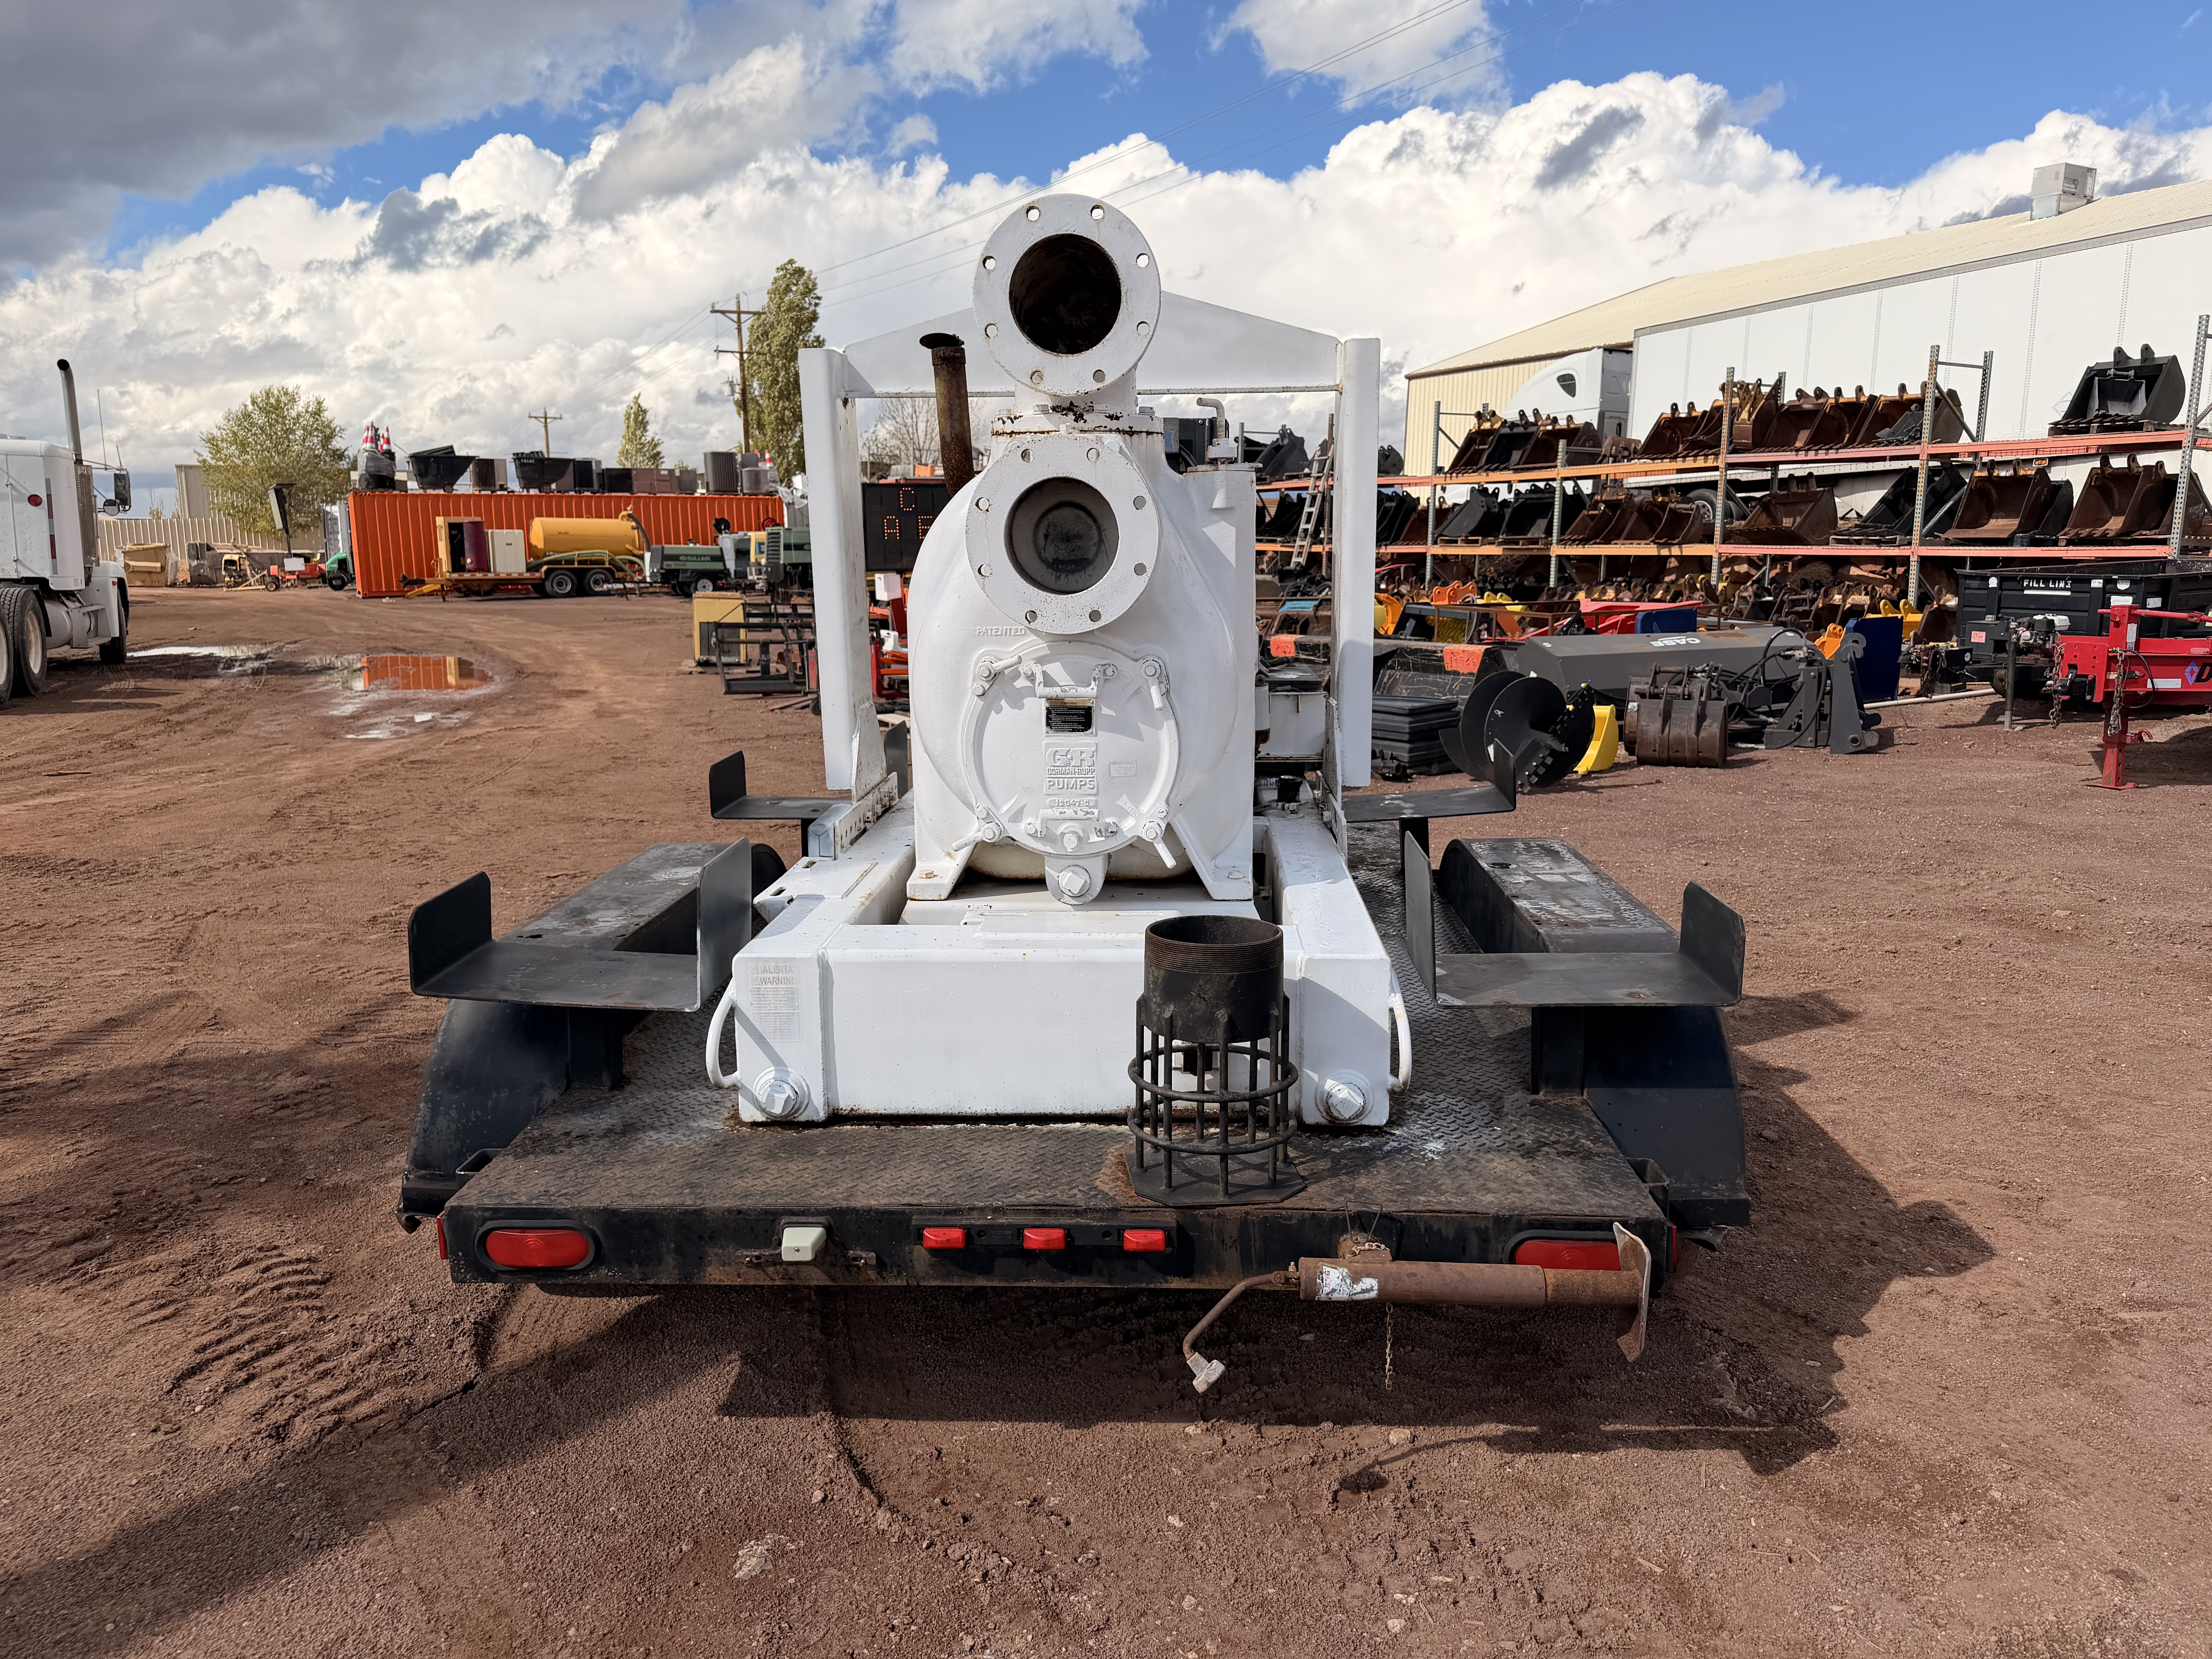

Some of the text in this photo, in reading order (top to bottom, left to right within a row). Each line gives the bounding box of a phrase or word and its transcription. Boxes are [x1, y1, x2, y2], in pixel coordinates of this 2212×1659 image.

[900, 487, 915, 511] C
[884, 516, 900, 539] A
[2023, 579, 2072, 588] FILL LINE
[977, 626, 1027, 637] PATENTED
[1650, 637, 1700, 647] CASE
[1047, 767, 1095, 776] GORMAN-RUPP
[1046, 778, 1096, 790] PUMPS
[759, 977, 797, 985] WARNING
